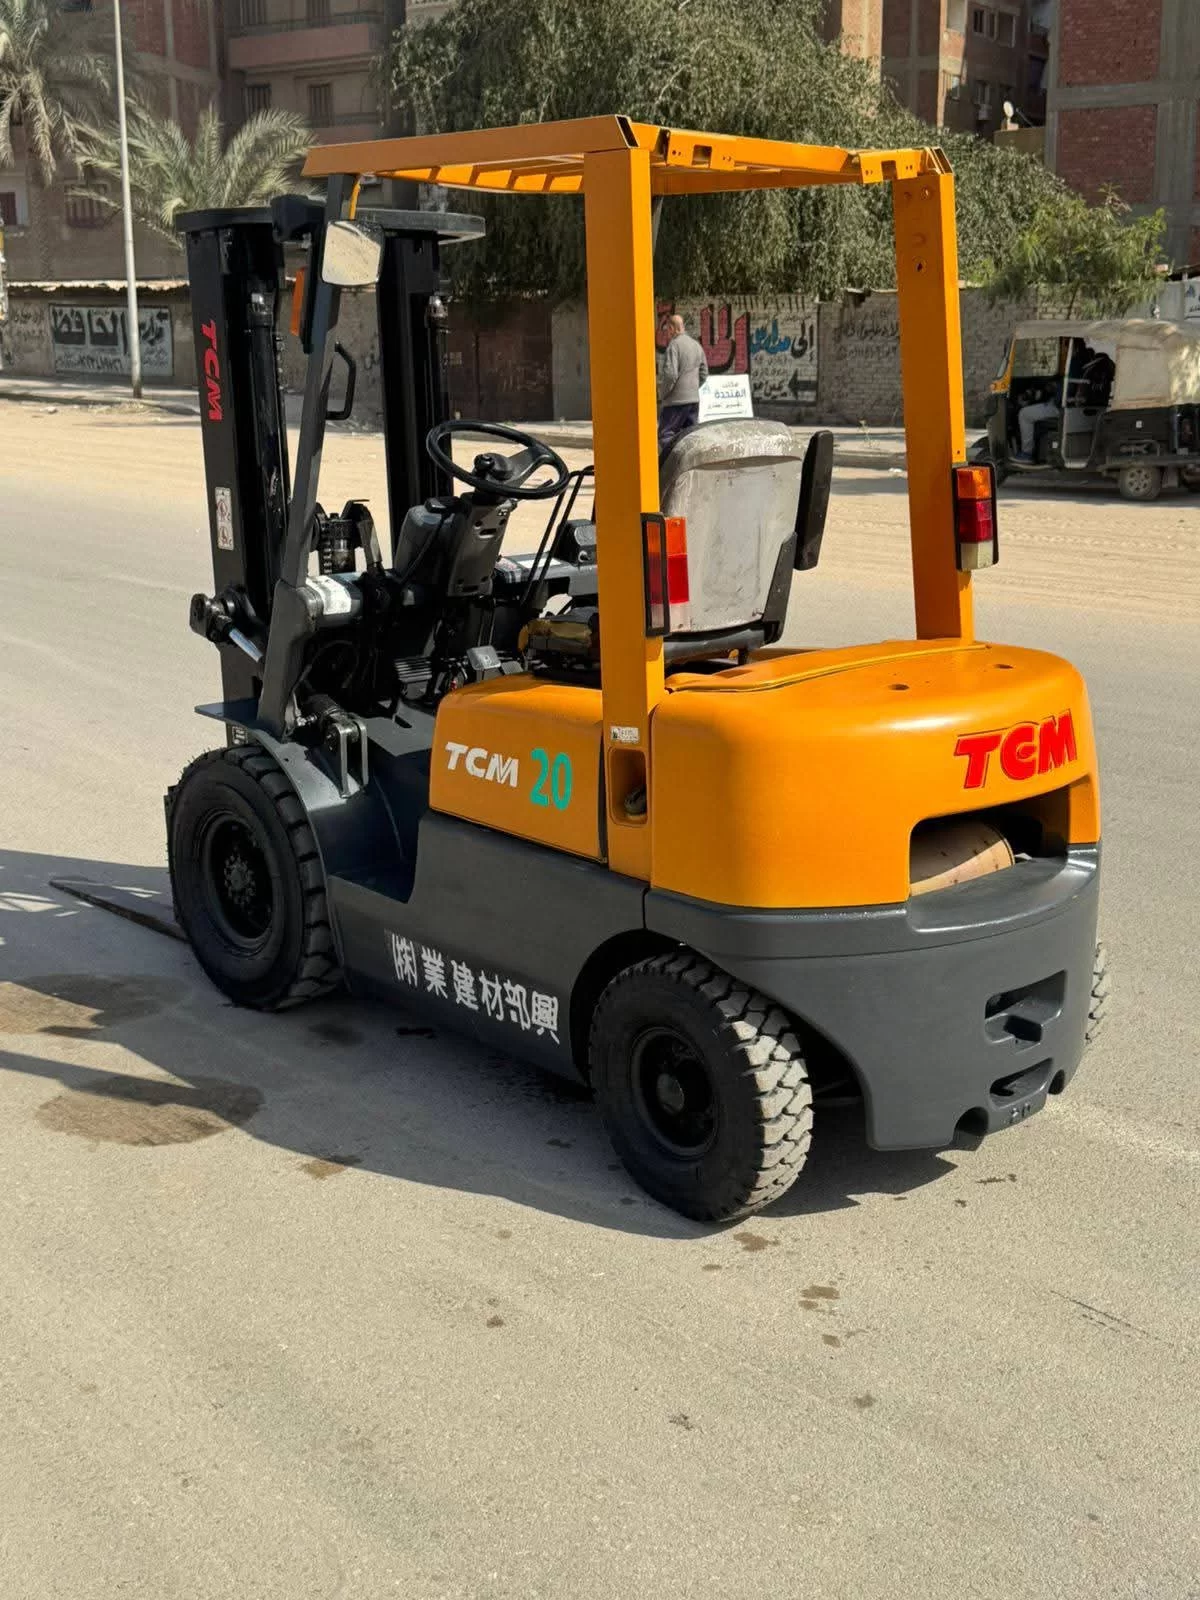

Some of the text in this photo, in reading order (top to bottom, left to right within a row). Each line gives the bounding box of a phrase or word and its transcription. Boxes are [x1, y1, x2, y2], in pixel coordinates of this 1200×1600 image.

[202, 319, 224, 421] TCM
[445, 741, 573, 811] TCM 20
[954, 709, 1077, 789] TCM
